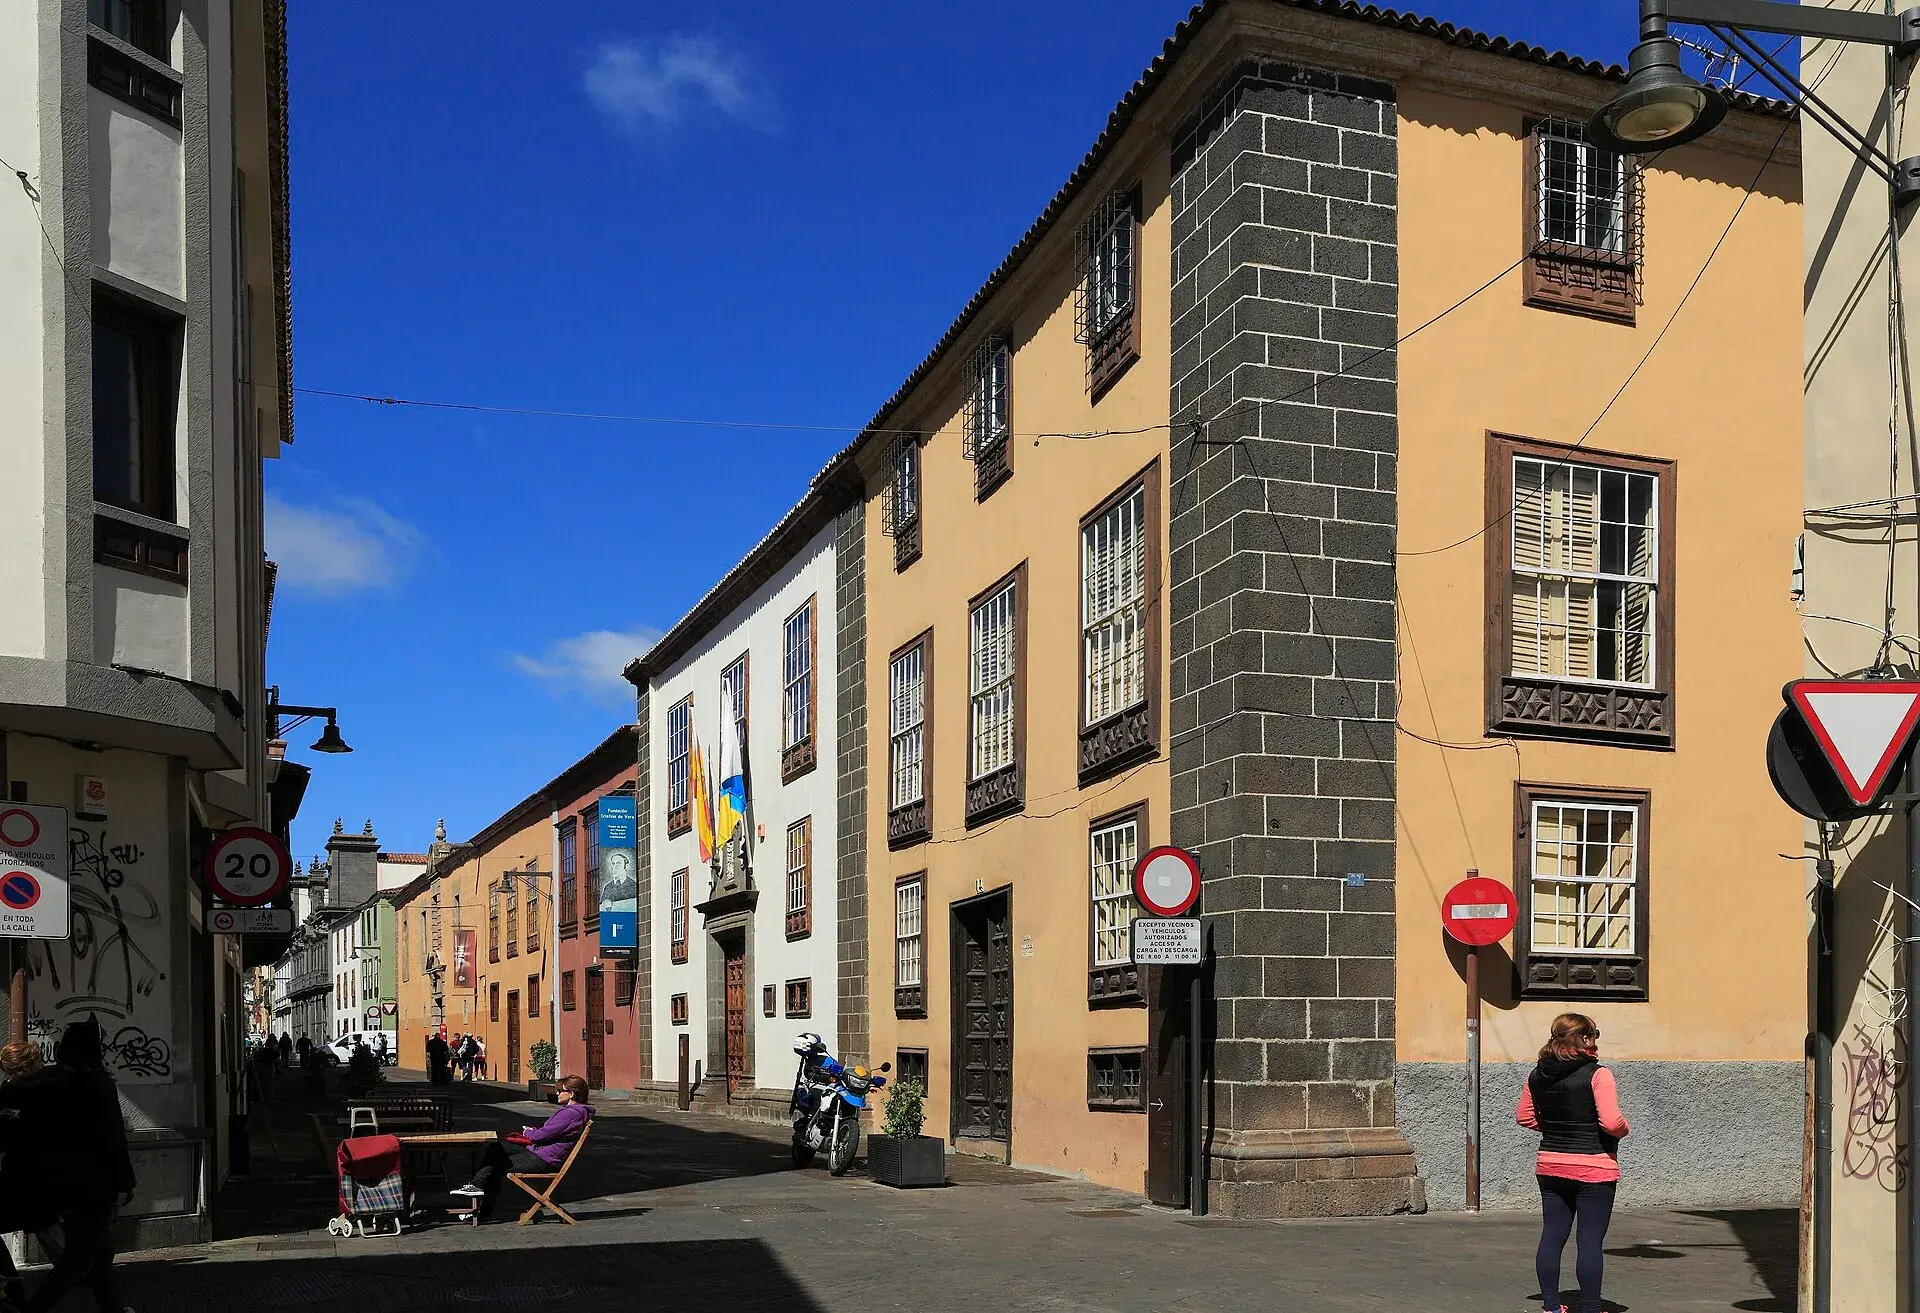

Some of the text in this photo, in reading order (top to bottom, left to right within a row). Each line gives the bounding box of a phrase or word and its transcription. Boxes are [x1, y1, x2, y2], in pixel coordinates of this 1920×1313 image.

[224, 853, 271, 878] 20
[3, 914, 34, 923] EN TODA
[13, 924, 35, 932] CALLE
